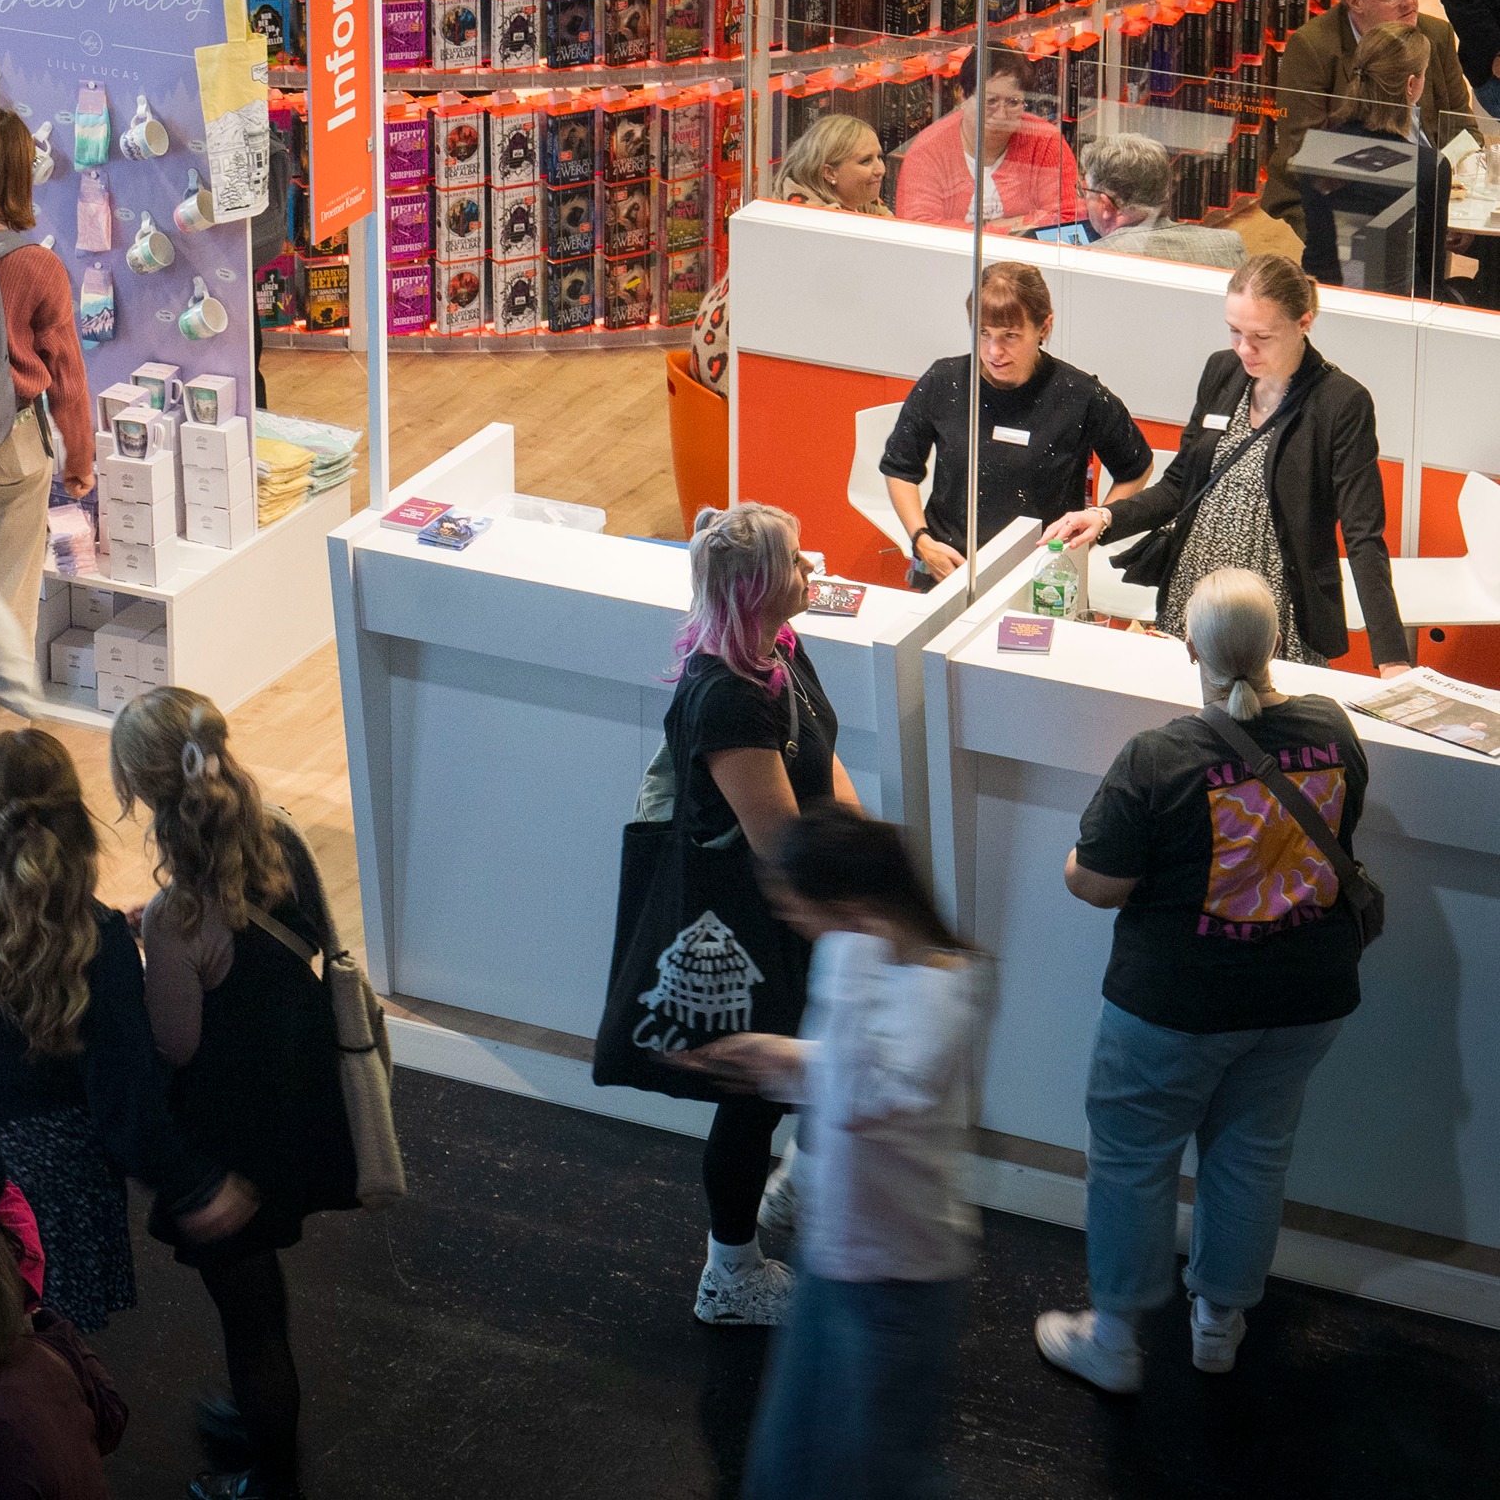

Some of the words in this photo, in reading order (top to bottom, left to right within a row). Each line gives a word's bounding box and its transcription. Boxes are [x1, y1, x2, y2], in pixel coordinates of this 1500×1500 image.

[81, 32, 99, 52] by
[47, 58, 87, 73] LILLY
[92, 63, 140, 82] LUCAS
[320, 201, 346, 223] Droemer
[1422, 673, 1444, 686] der
[1444, 682, 1486, 700] Freitag
[1206, 742, 1346, 788] SUHINE
